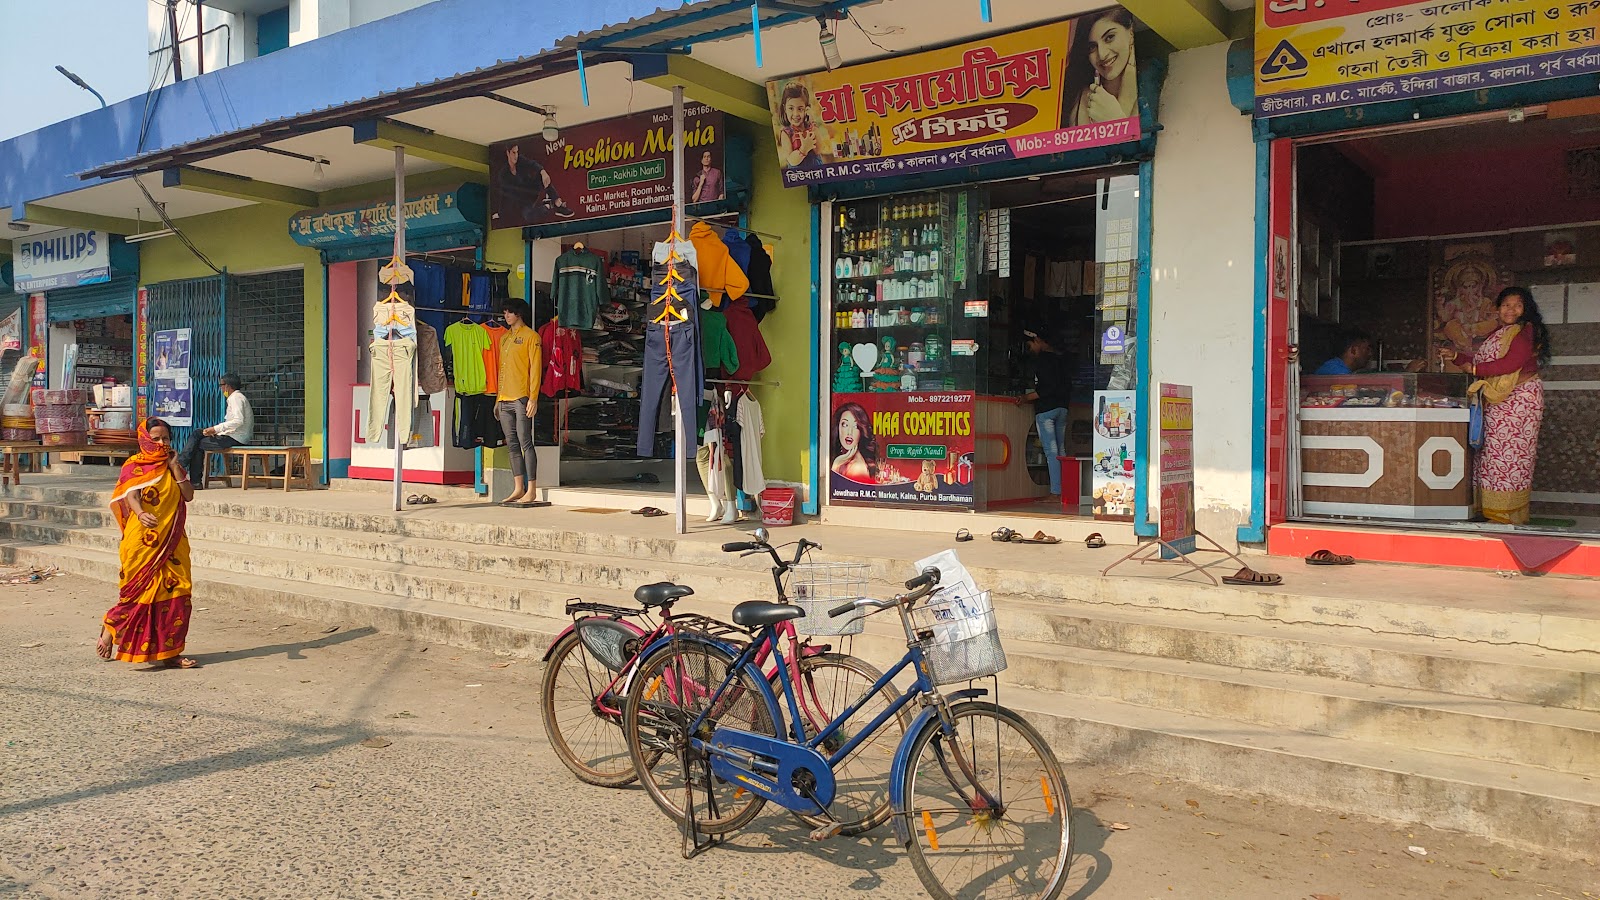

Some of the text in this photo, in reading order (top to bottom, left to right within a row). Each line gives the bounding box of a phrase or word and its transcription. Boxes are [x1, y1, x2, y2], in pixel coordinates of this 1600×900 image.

[1312, 40, 1366, 58] এখানে
[1371, 23, 1435, 50] হলমার্ক
[1440, 21, 1477, 43] যুক্ত
[1485, 9, 1536, 32] সোনা
[1544, 7, 1560, 20] ও
[1338, 27, 1597, 78] গহনা তৈরী ও বিক্রয় করা হয়
[1312, 90, 1354, 105] R.M.C.
[1357, 81, 1398, 98] মার্কেট,
[1400, 76, 1438, 92] ইন্দিরা
[1442, 70, 1485, 86] বাজার,
[1488, 63, 1535, 80] কালনা,
[1539, 55, 1565, 76] পূর্ব
[814, 83, 857, 124] মা
[545, 137, 565, 155] New
[1016, 121, 1130, 152] Mob:- 8972219277
[564, 137, 635, 170] Fashion
[786, 139, 1007, 183] জিউধারা R.M.C মার্কেট কালনা পূর্ব বর্ধমান
[614, 169, 637, 180] Rakhib
[640, 163, 662, 175] Nandi
[604, 189, 629, 200] Market,
[631, 186, 652, 195] Room
[609, 199, 630, 209] Purba
[632, 193, 674, 206] Bardhaman
[33, 230, 97, 265] PHILIPS
[26, 278, 58, 289] ENTERPRISE
[929, 395, 971, 403] 8972219277
[873, 412, 970, 438] MAA COSMETICS
[924, 446, 944, 456] Nandi
[878, 491, 899, 500] Market,
[920, 493, 937, 502] Purba
[939, 493, 973, 503] Bardhaman
